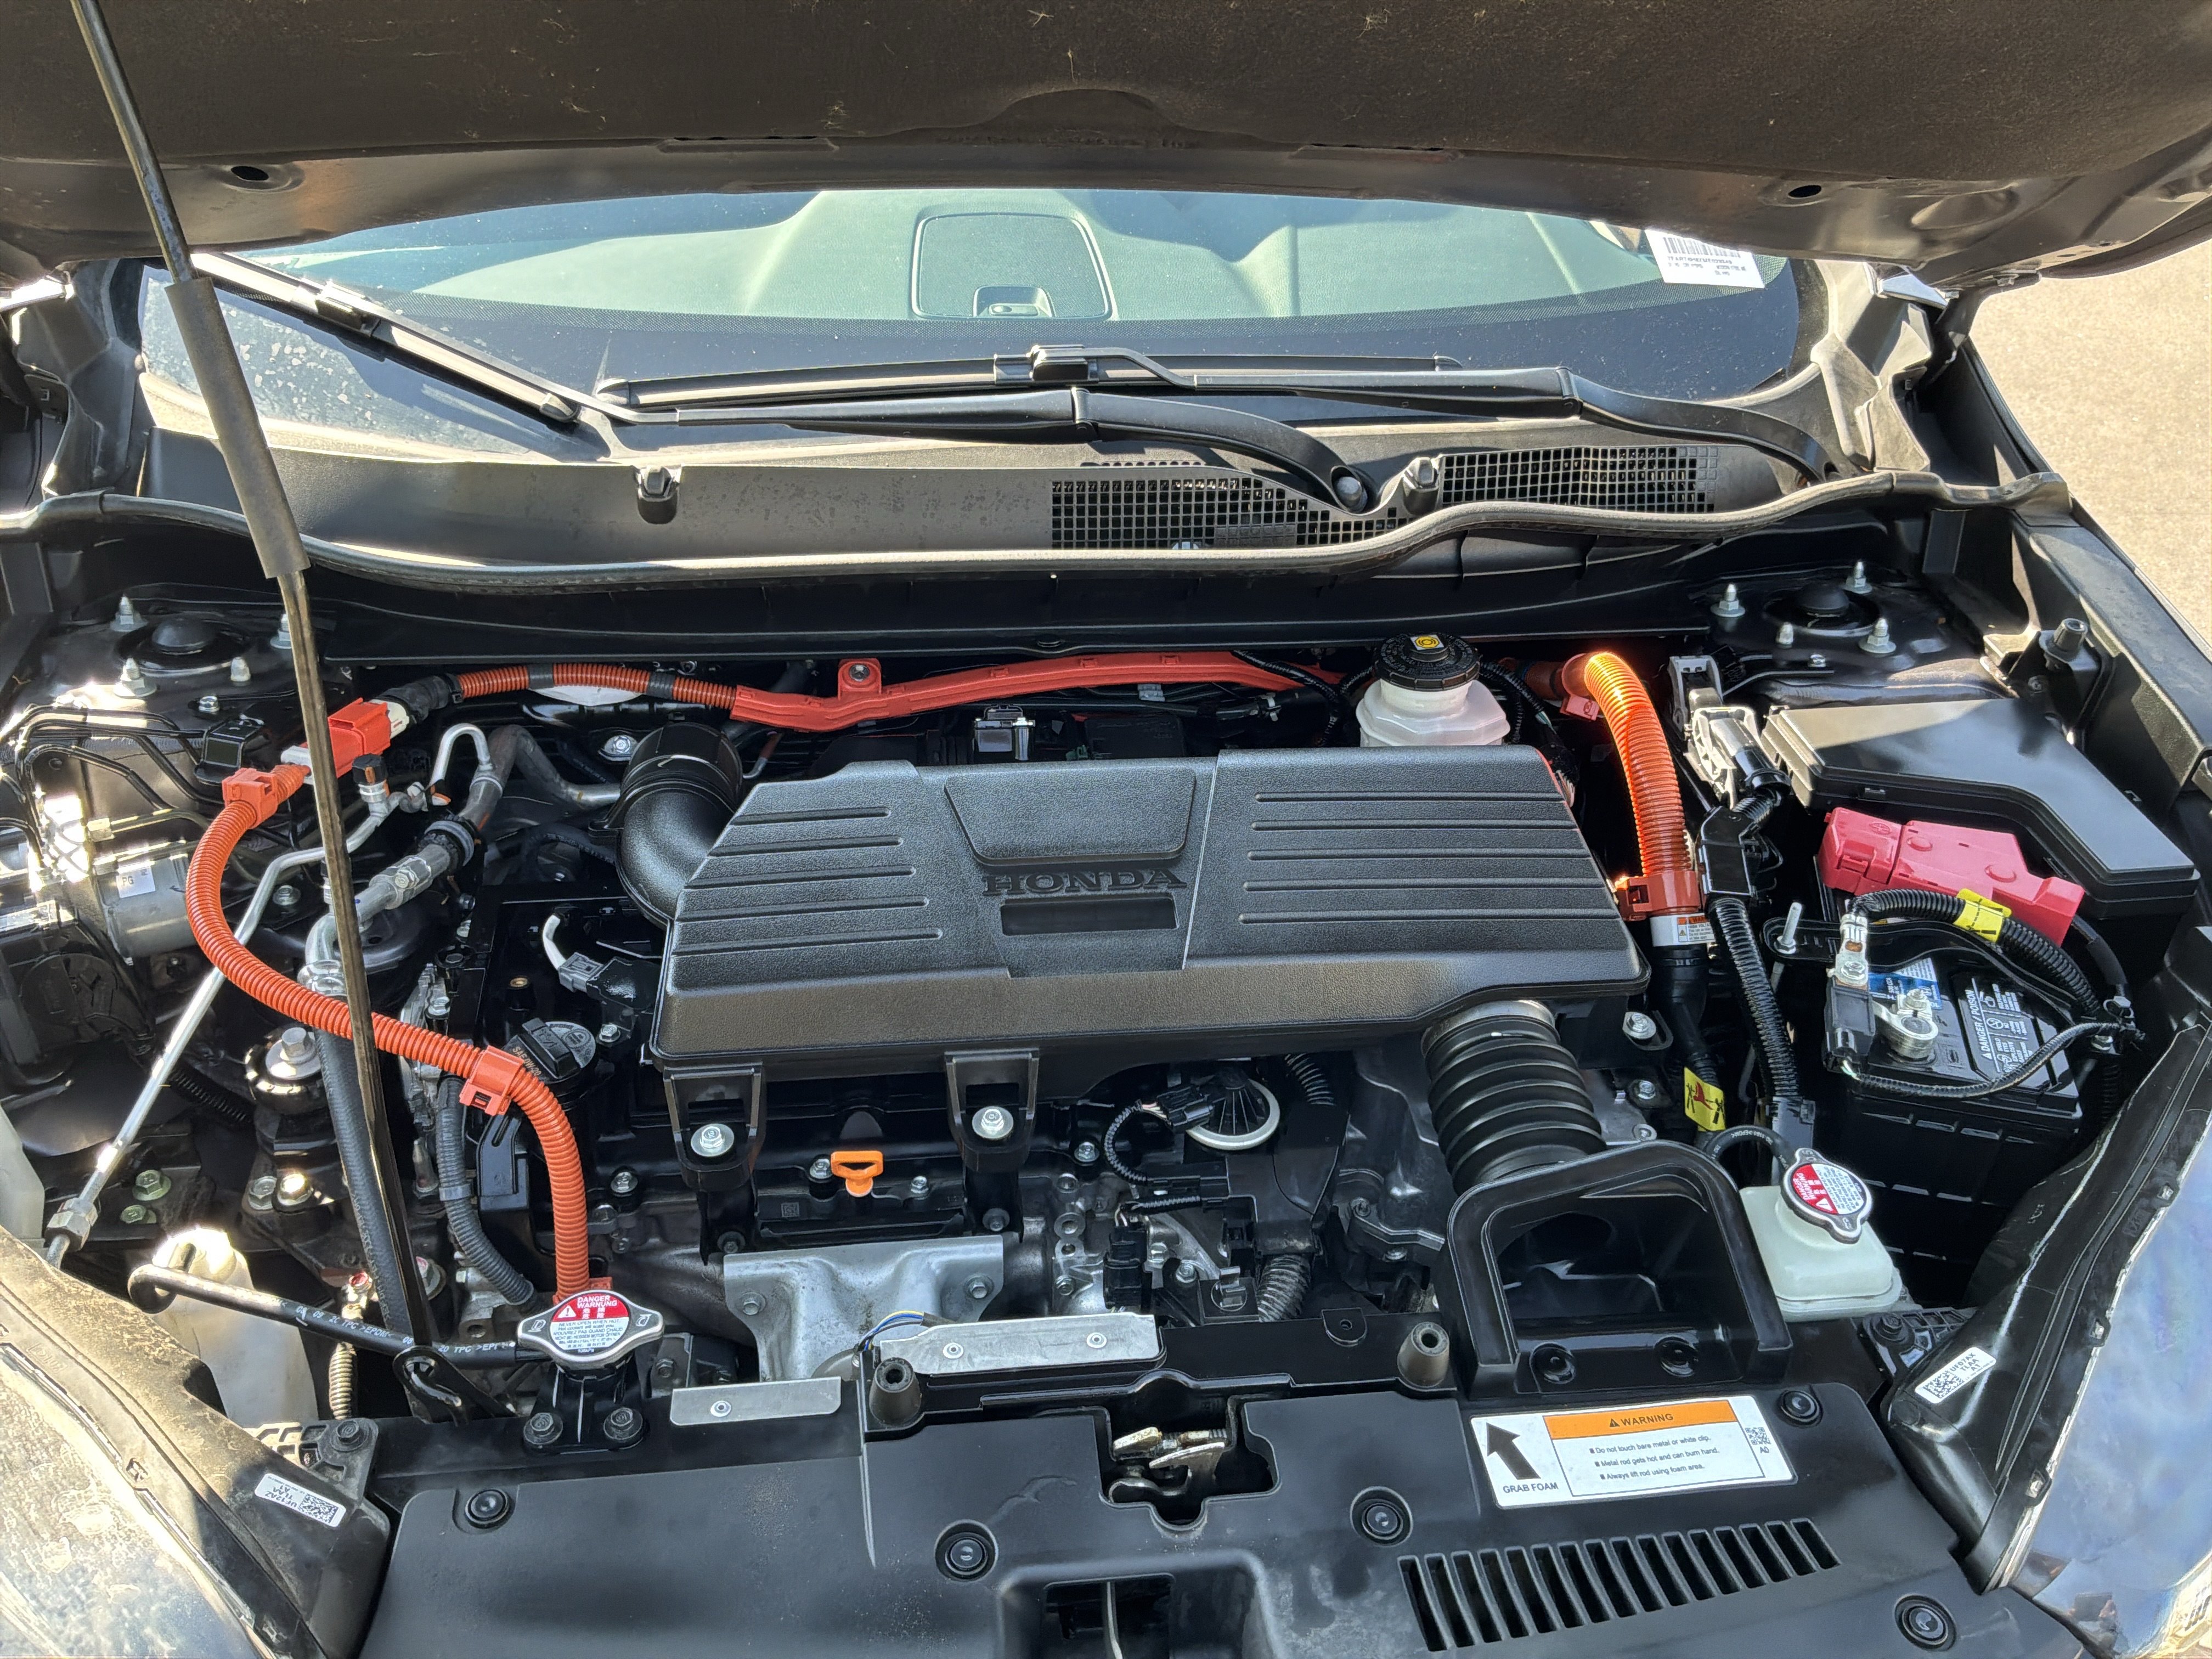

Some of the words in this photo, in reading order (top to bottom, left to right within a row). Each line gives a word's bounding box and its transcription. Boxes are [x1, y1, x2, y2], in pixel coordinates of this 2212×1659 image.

[122, 876, 134, 886] PG
[983, 867, 1187, 896] HONDA
[1965, 989, 1980, 1015] POISON
[1974, 1022, 1991, 1052] DANGER
[512, 1046, 527, 1060] SAE
[1793, 1178, 1808, 1201] DANGER
[1797, 1173, 1816, 1200] WARNUNG
[578, 1300, 618, 1308] WARNUNG
[341, 1319, 359, 1330] TPC
[1960, 1359, 1979, 1371] TLAA
[1620, 1412, 1674, 1426] WARNING
[1653, 1440, 1671, 1448] metal
[1698, 1435, 1711, 1443] clip.
[1607, 1471, 1630, 1480] Always
[1652, 1468, 1670, 1476] using
[273, 1487, 293, 1499] TLAA
[1503, 1483, 1530, 1494] GRAB
[1531, 1481, 1559, 1492] FOAM
